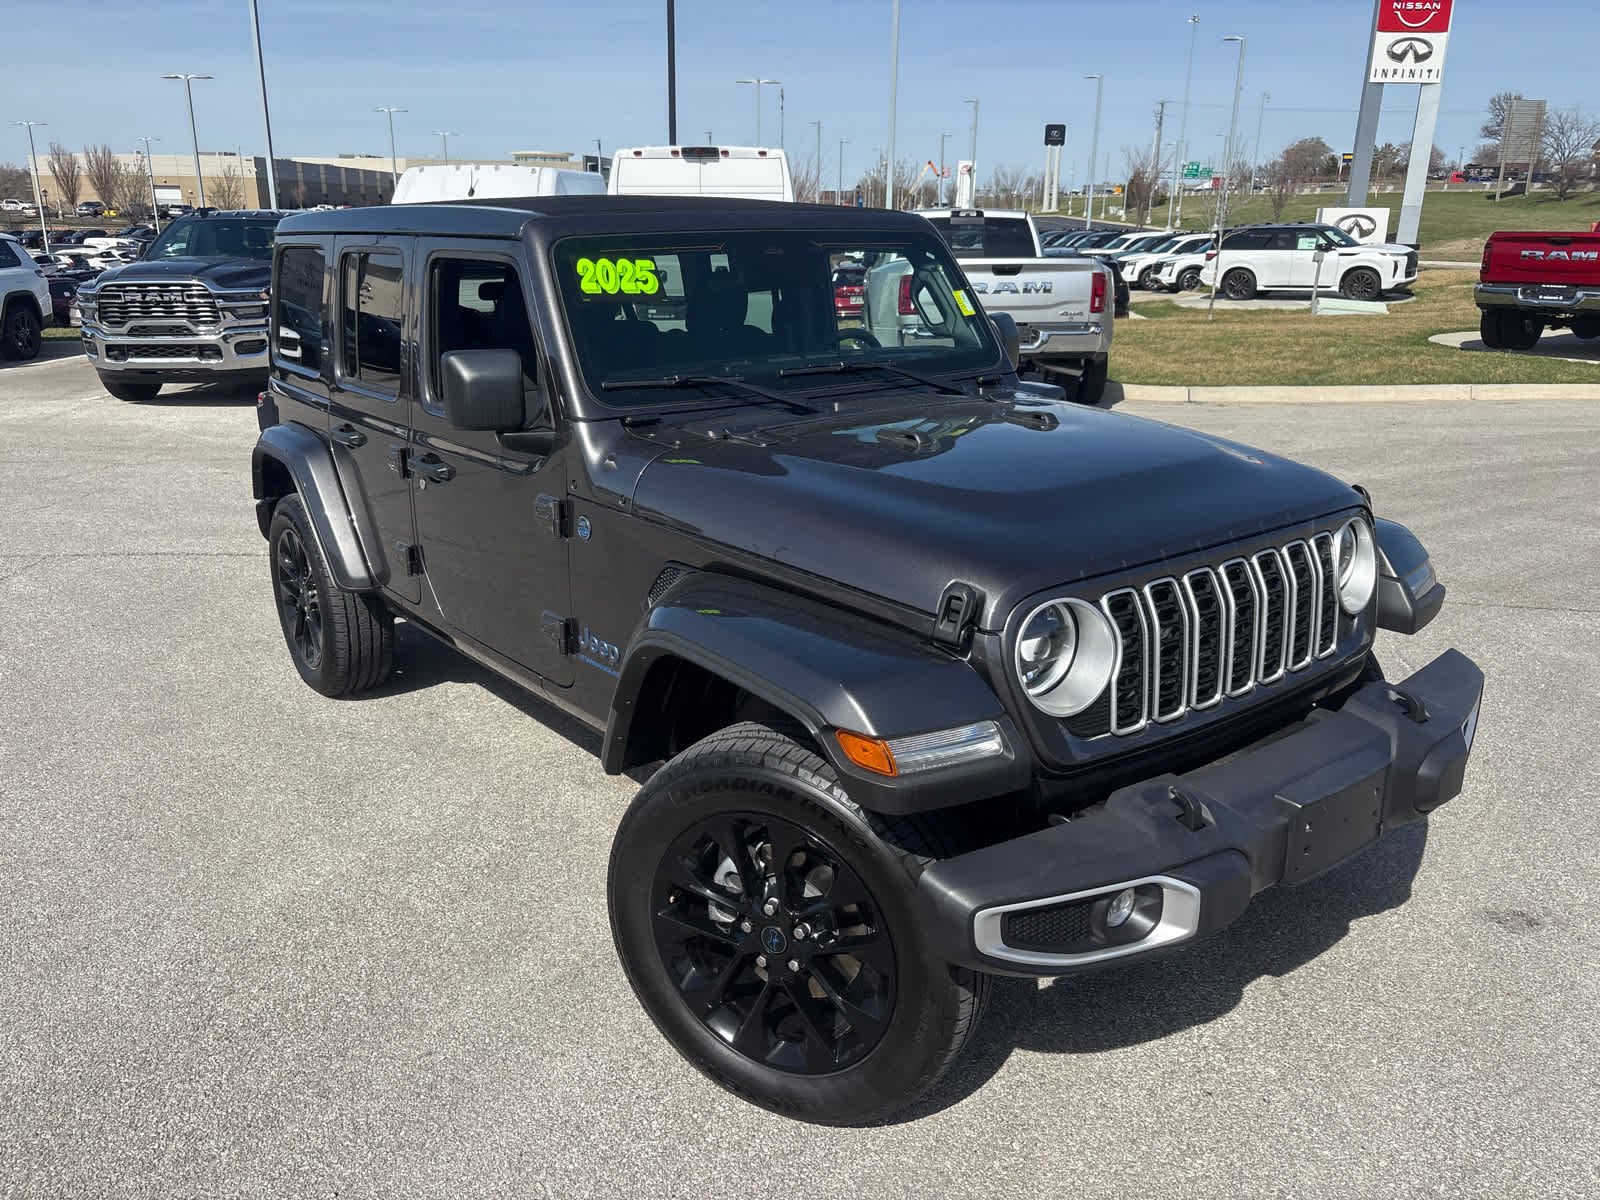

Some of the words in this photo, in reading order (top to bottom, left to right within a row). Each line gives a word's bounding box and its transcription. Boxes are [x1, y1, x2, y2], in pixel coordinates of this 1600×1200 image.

[1392, 2, 1441, 10] NISSAN
[1373, 68, 1440, 79] INFINITI
[1520, 250, 1599, 260] RAM
[576, 257, 659, 295] 2025
[124, 291, 183, 302] RAM
[578, 624, 619, 666] Jeep
